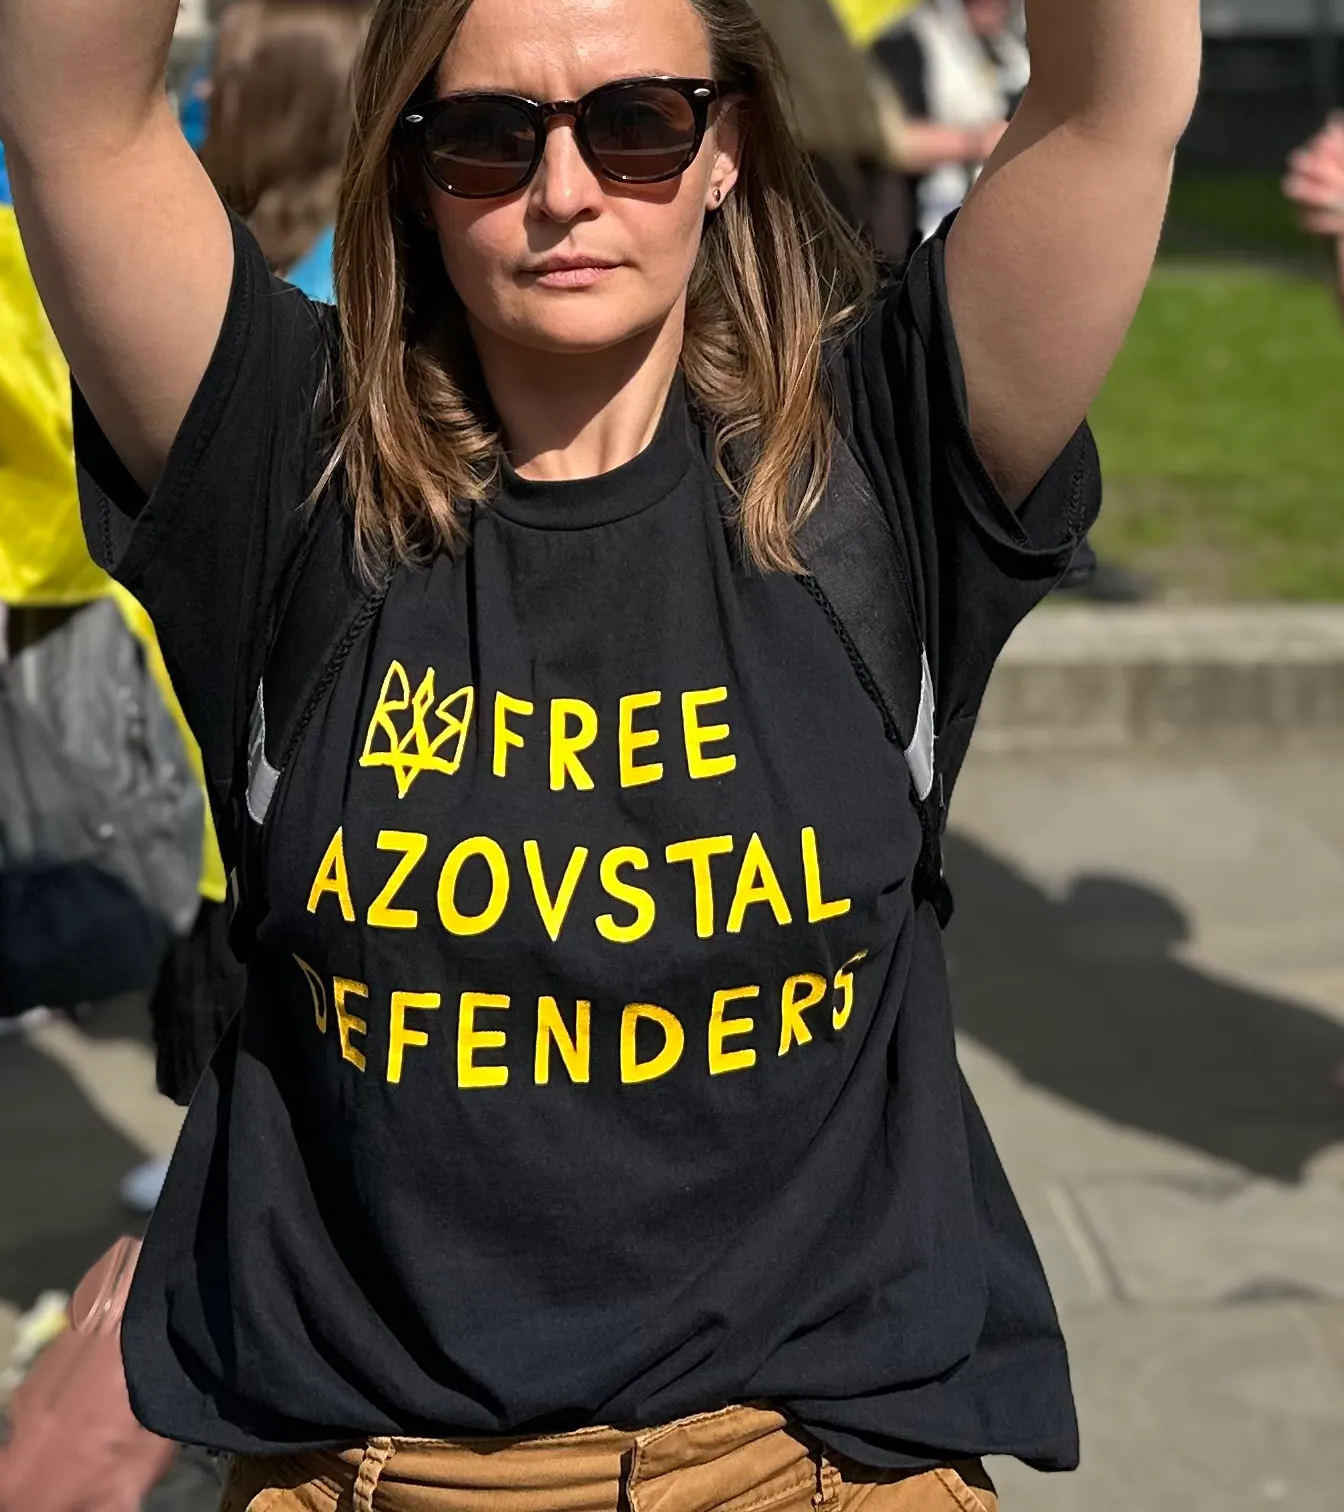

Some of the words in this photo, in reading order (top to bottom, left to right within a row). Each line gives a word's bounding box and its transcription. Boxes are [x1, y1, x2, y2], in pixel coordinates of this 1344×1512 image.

[493, 686, 737, 792] FREE
[306, 825, 853, 944] AZOVSTAL
[292, 948, 869, 1090] DEFENDERS
